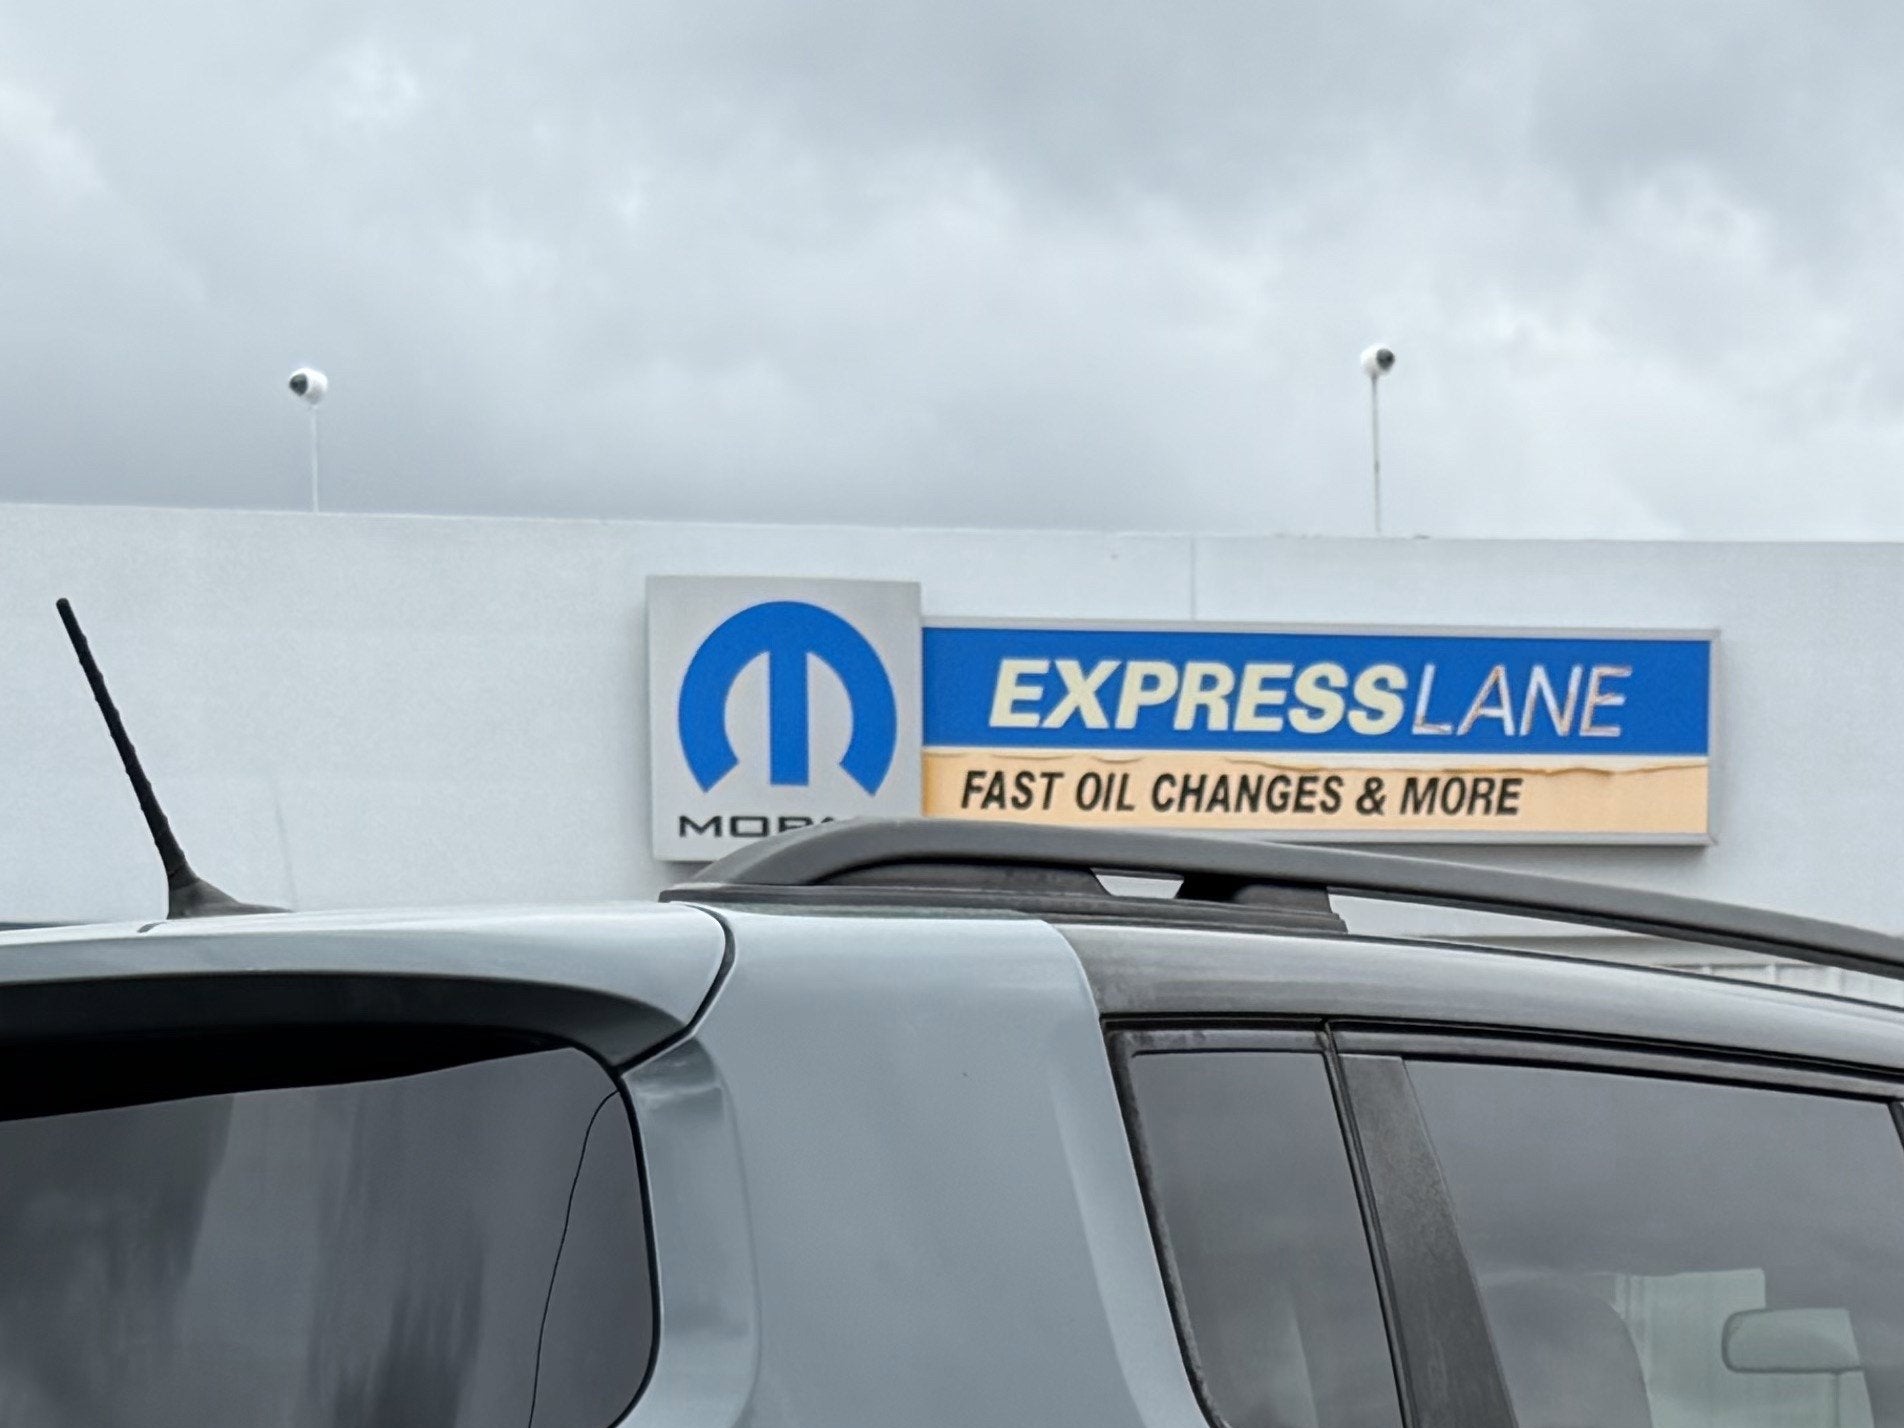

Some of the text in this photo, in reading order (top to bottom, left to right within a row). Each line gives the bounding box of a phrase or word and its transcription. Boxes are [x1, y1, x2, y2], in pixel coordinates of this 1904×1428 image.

[960, 769, 1524, 817] FAST OIL CHANGES & MORE
[678, 815, 835, 838] MOP
